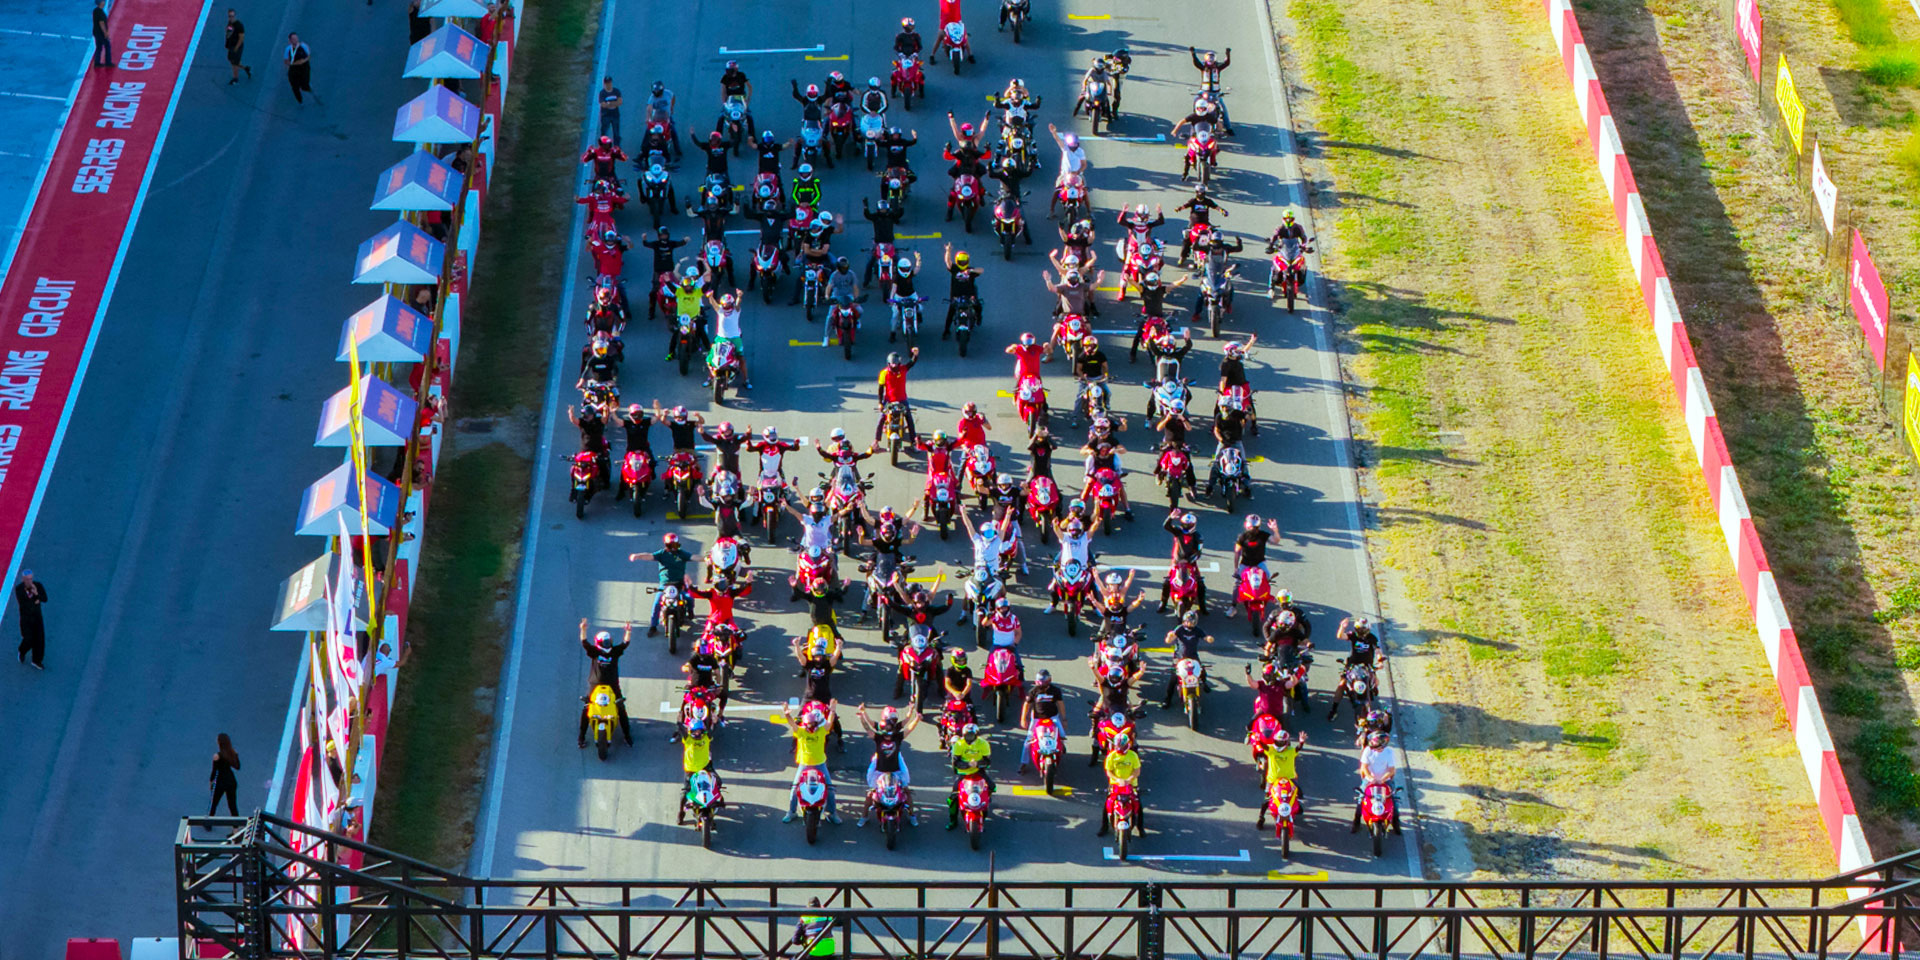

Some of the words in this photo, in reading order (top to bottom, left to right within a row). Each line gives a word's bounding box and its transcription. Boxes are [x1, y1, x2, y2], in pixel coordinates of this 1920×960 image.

[118, 23, 168, 71] CIRCUIT
[95, 82, 146, 129] RACING
[71, 138, 126, 194] SERRES
[17, 277, 76, 337] CIRCUIT
[0, 350, 49, 410] RACING
